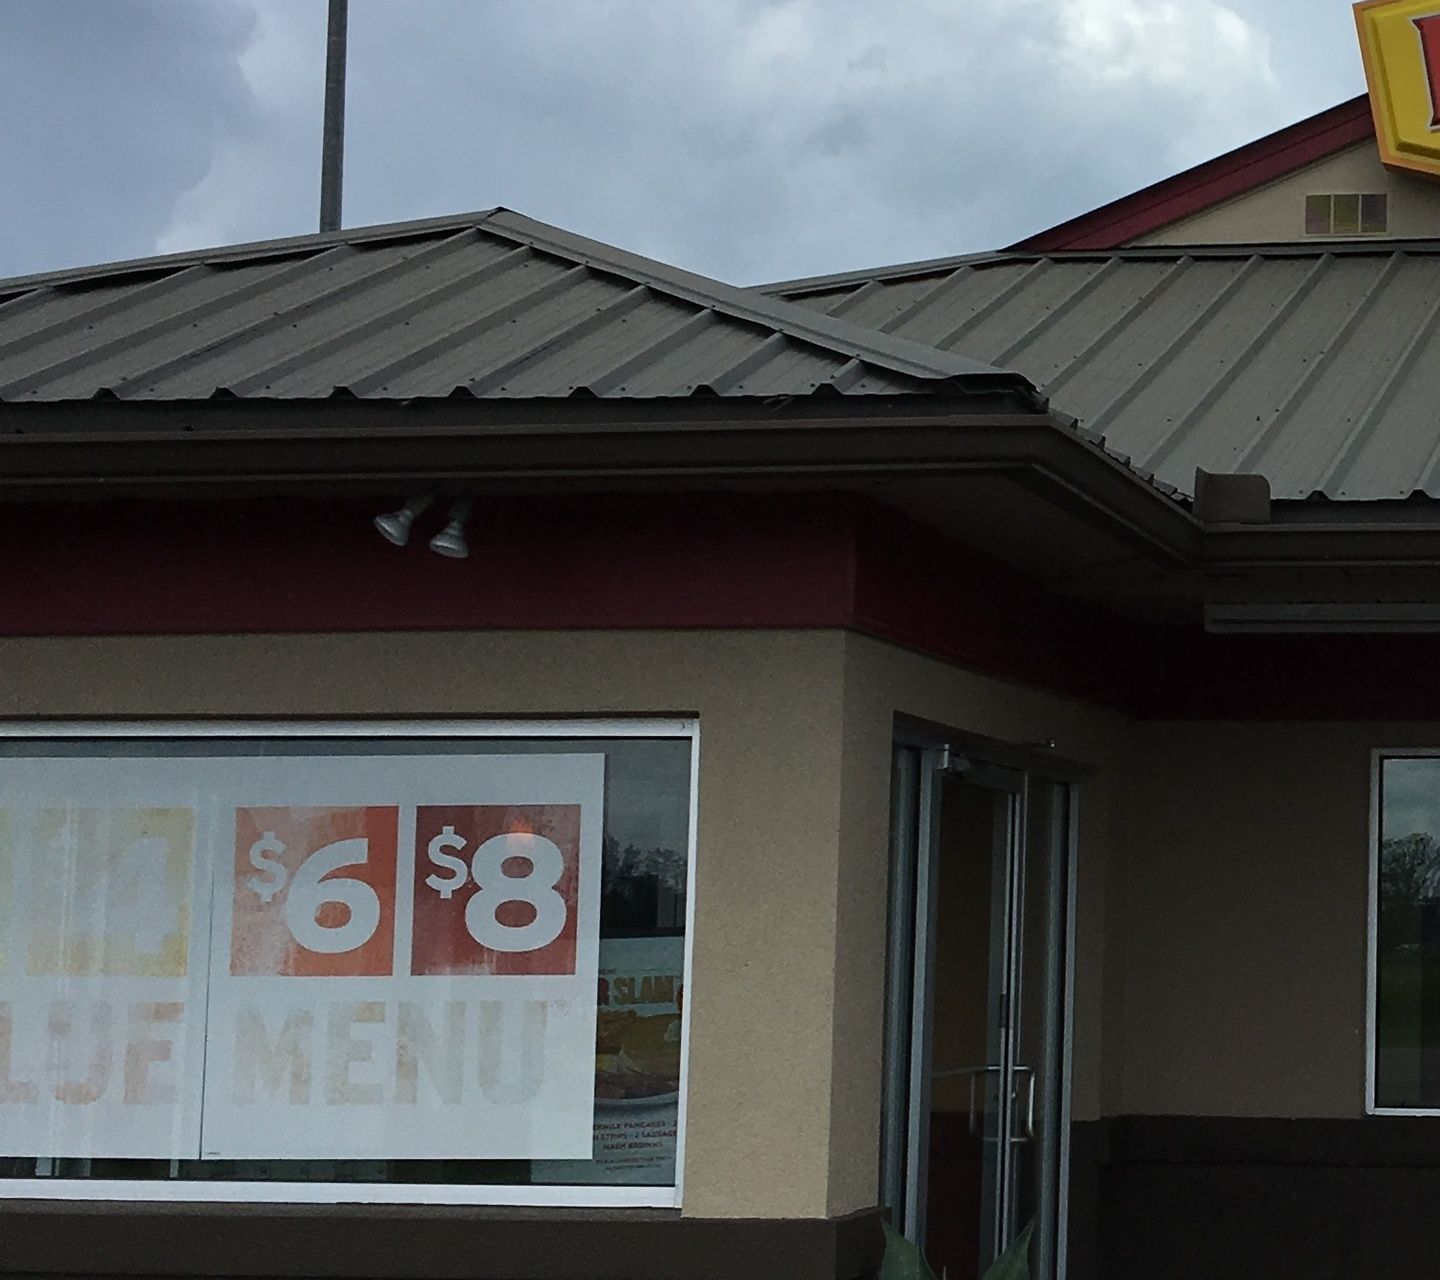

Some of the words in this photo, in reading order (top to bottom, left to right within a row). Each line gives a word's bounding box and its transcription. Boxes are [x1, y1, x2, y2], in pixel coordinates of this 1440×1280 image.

[247, 831, 381, 954] $6
[425, 826, 566, 951] $8
[231, 1000, 548, 1105] MENU
